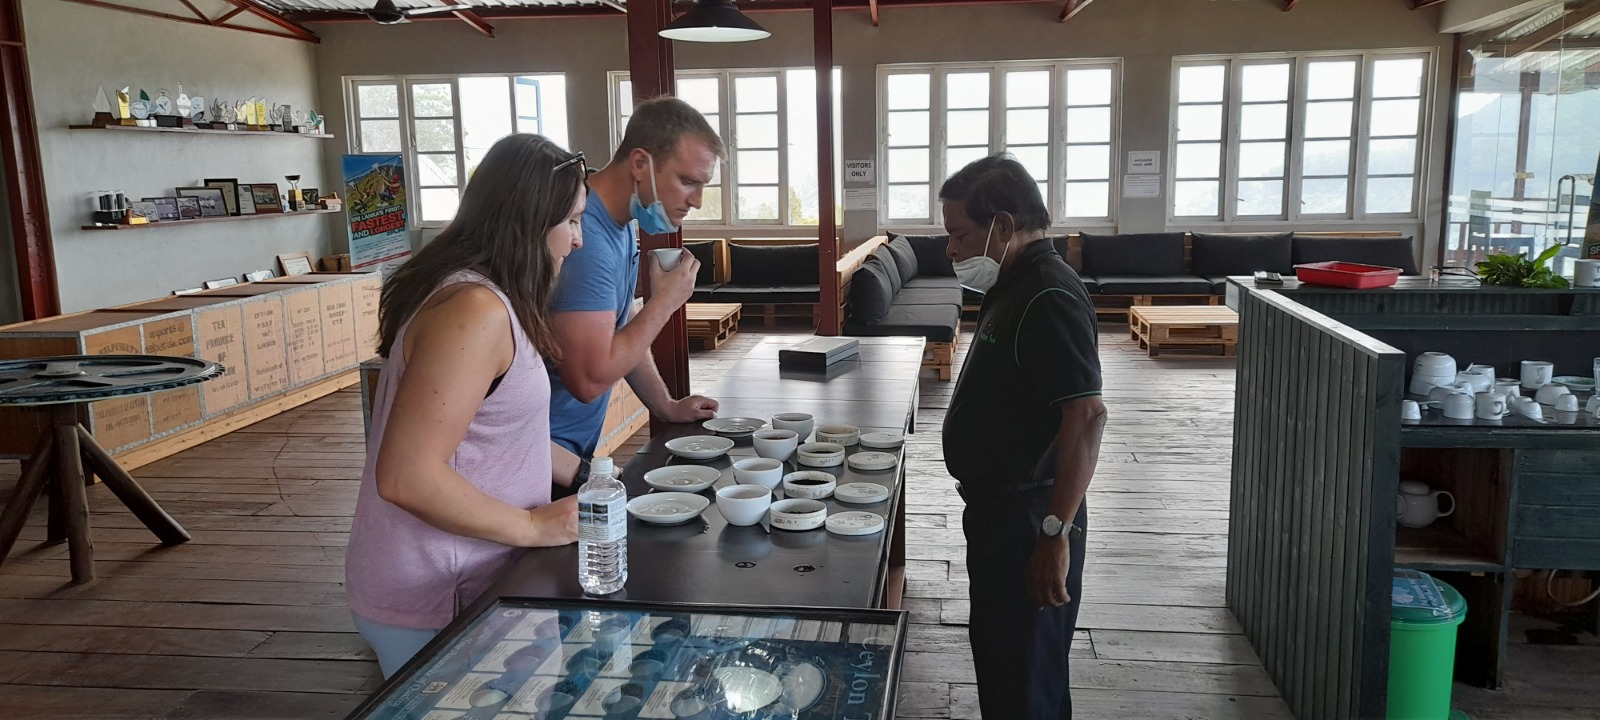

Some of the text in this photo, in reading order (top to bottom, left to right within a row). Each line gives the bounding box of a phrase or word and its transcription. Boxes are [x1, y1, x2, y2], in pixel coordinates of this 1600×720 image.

[352, 210, 403, 232] FASTEST
[361, 210, 384, 220] LANKA'S
[384, 206, 400, 214] FIRST
[353, 220, 405, 239] AND LONGEST
[211, 319, 226, 331] TEA
[205, 333, 234, 350] PRODUCE
[217, 352, 226, 362] OF
[847, 636, 887, 705] Ceylon
